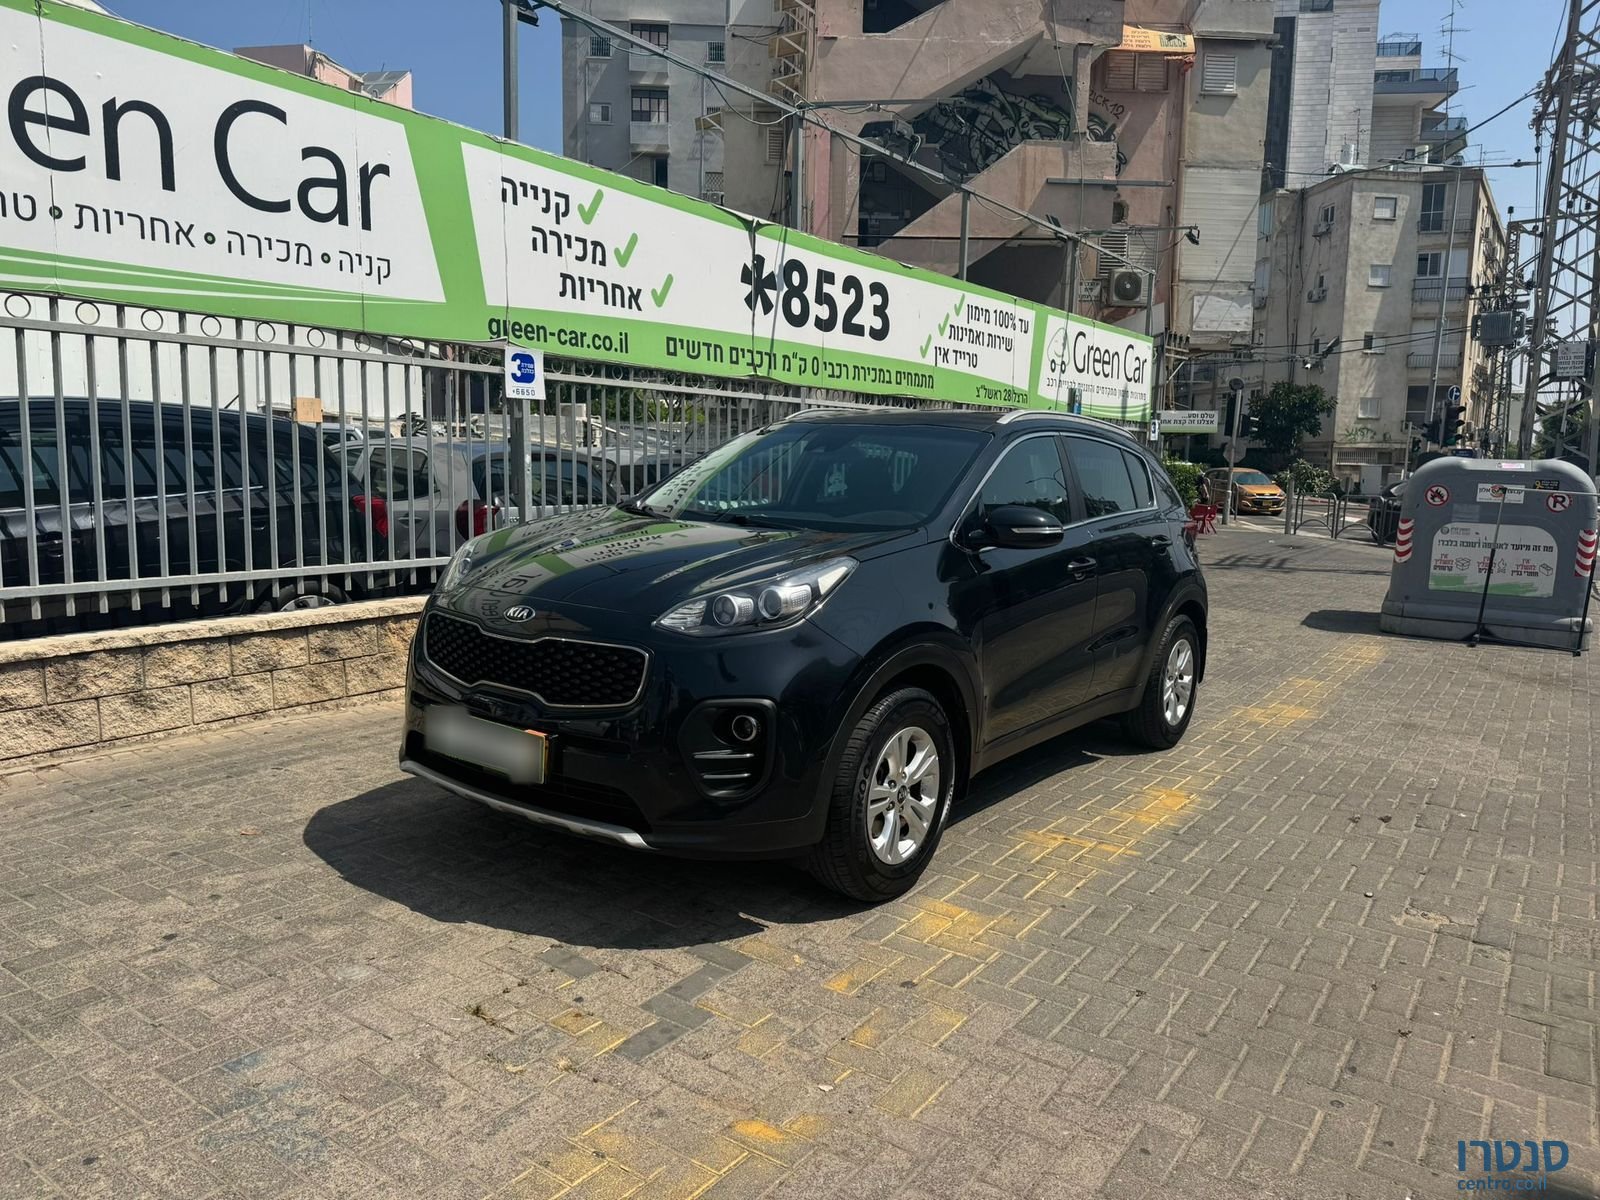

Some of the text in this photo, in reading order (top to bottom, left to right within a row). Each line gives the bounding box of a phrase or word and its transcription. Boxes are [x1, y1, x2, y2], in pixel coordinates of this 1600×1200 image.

[213, 99, 391, 231] Car
[501, 177, 571, 225] קנייה
[74, 202, 197, 248] אחריות
[227, 230, 313, 267] מכירה
[531, 226, 607, 267] מכירה
[338, 251, 391, 285] קניה
[559, 272, 643, 312] אחריות
[967, 304, 1029, 334] עד 100% מימון
[488, 317, 630, 354] green-car.co.il
[665, 336, 724, 363] חדשים
[948, 324, 1013, 352] שירות ואמינות
[729, 346, 777, 371] ורכבים
[811, 356, 820, 376] 0
[823, 361, 850, 380] רכבי
[934, 346, 978, 369] טרייד אין
[1073, 330, 1148, 384] Green Car
[852, 364, 893, 385] במכירת
[895, 369, 935, 389] מתמחים
[1003, 388, 1011, 402] 28
[1012, 389, 1028, 404] הרצל
[507, 607, 528, 619] KIA
